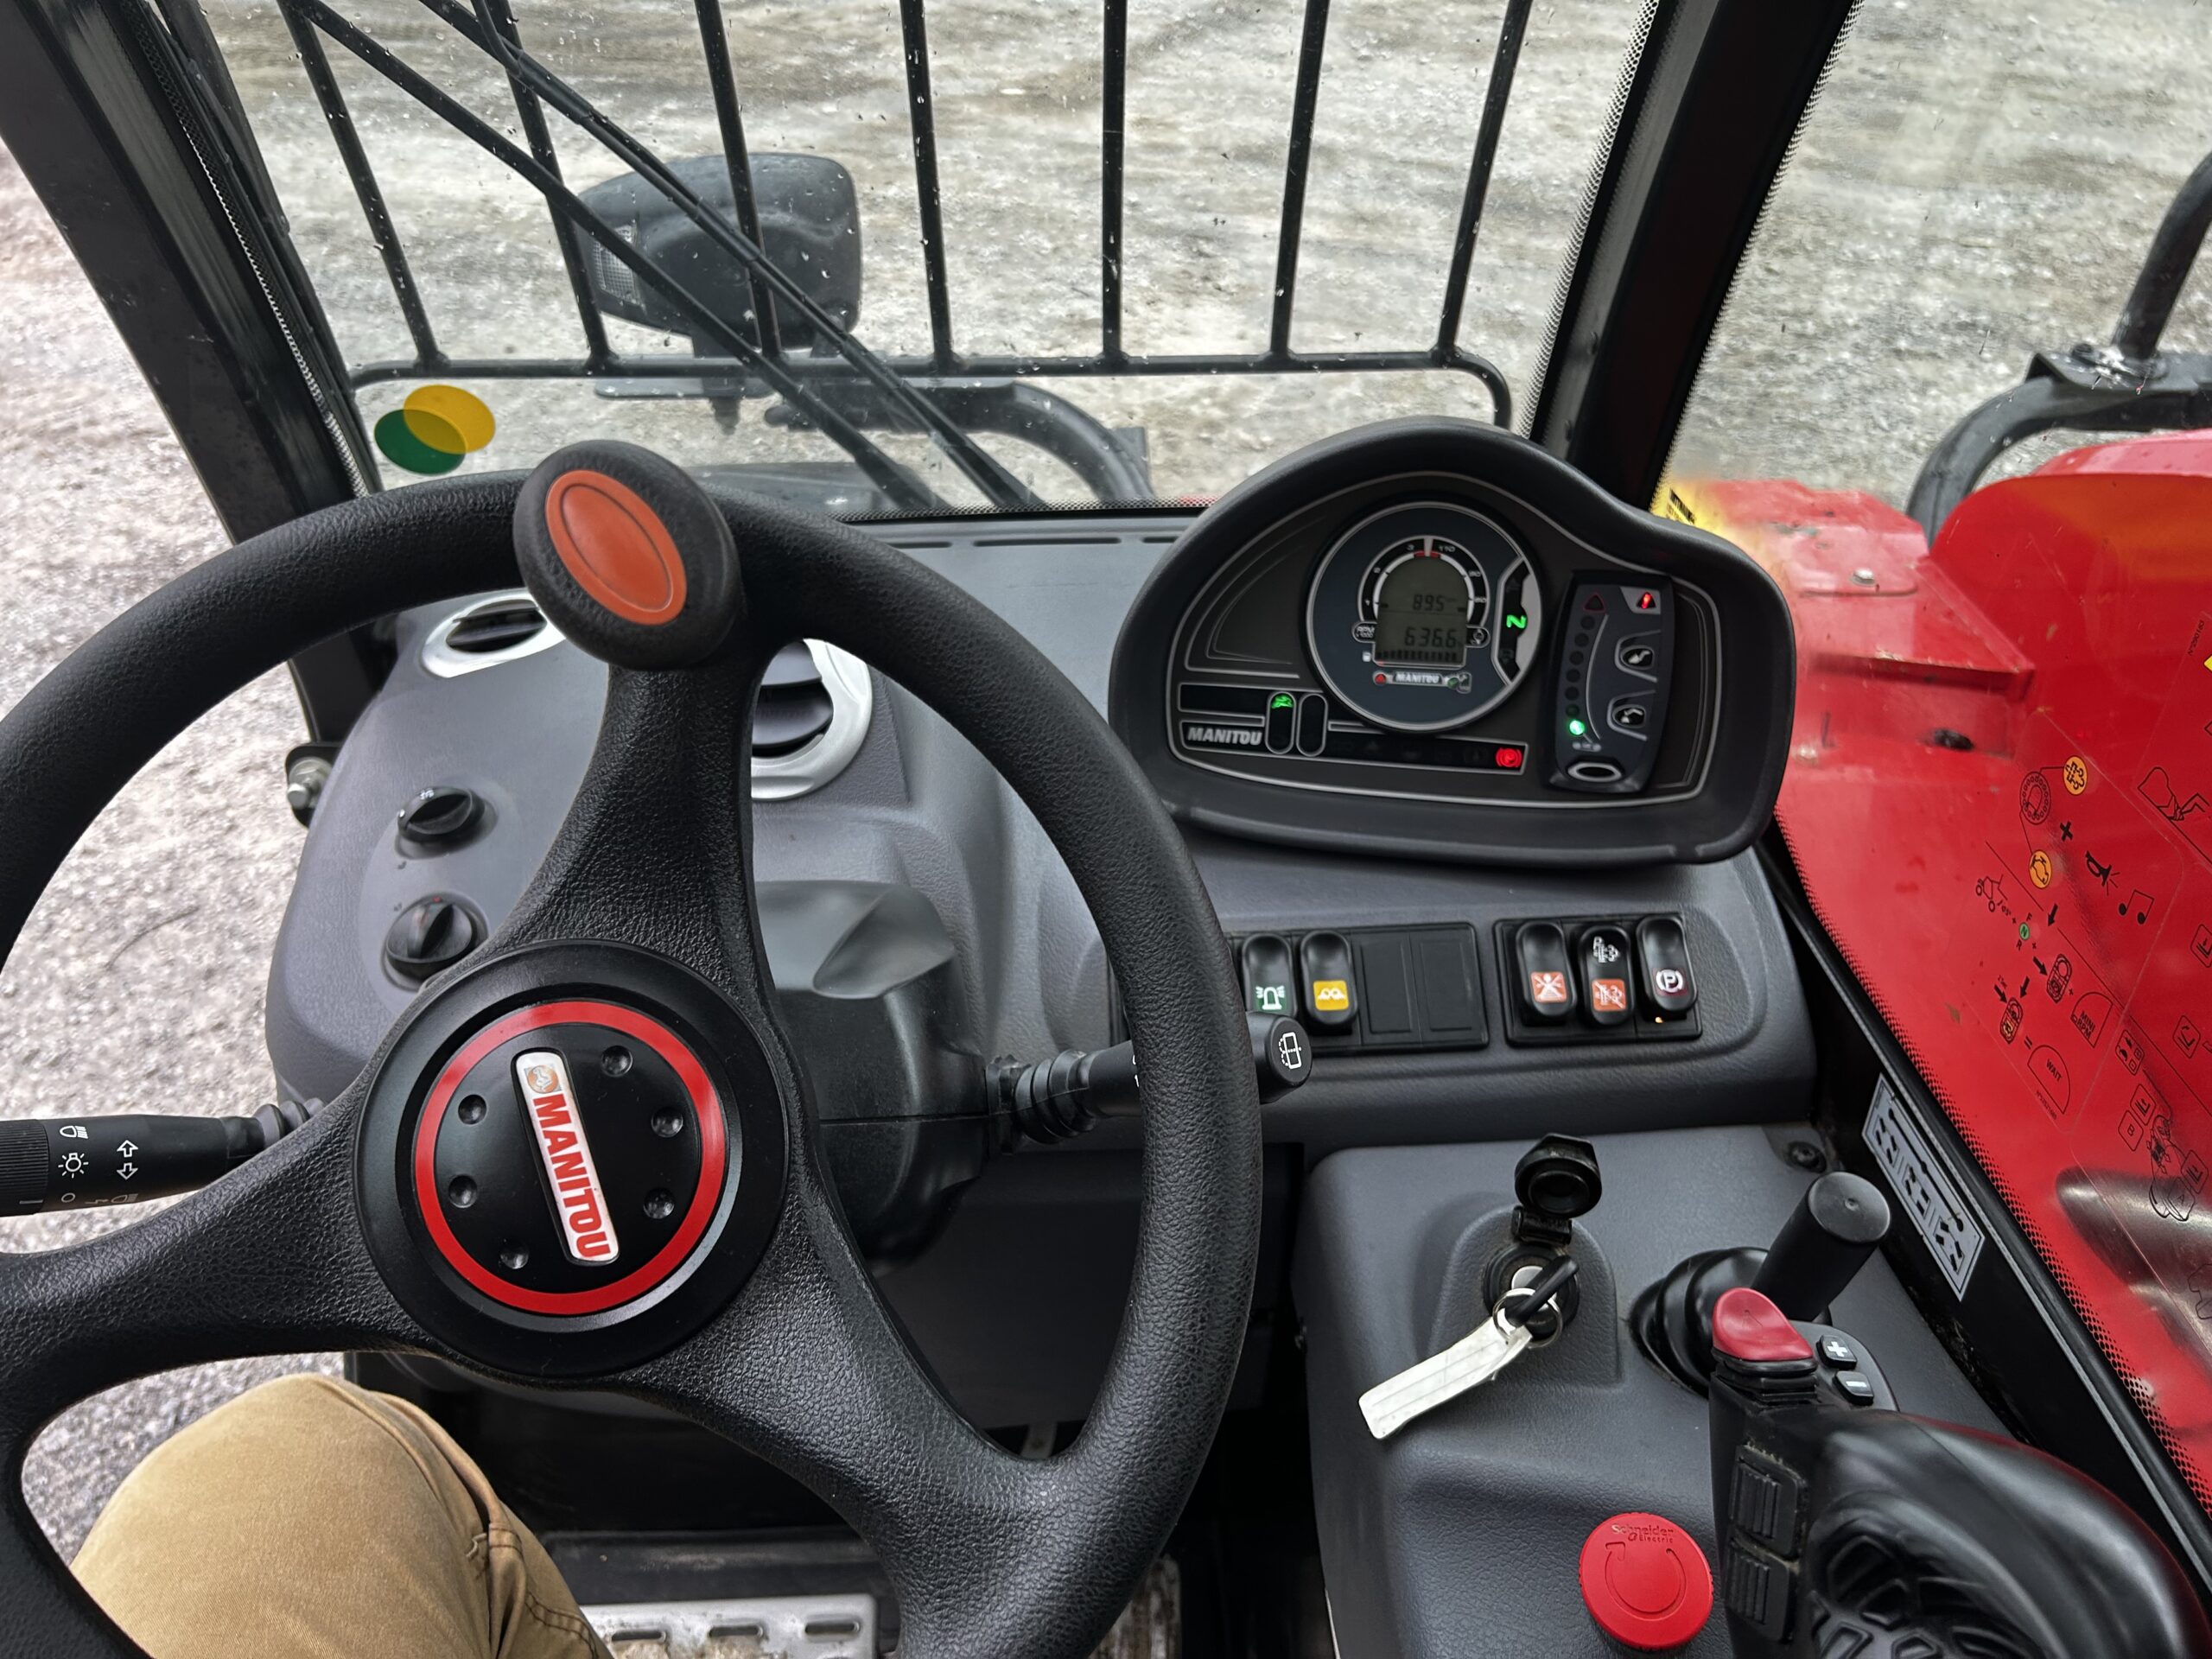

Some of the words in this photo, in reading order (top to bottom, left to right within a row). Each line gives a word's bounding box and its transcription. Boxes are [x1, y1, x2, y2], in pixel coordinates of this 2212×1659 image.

[1412, 594, 1445, 612] 895
[1395, 672, 1440, 684] MANITOU
[1187, 727, 1262, 746] MANITOU
[2076, 1018, 2092, 1039] RPM
[2080, 1010, 2096, 1033] MINI
[2046, 1058, 2063, 1082] WAIT
[532, 1093, 612, 1258] MANITOU
[1611, 1522, 1674, 1536] Schneider
[1638, 1534, 1674, 1543] Electric
